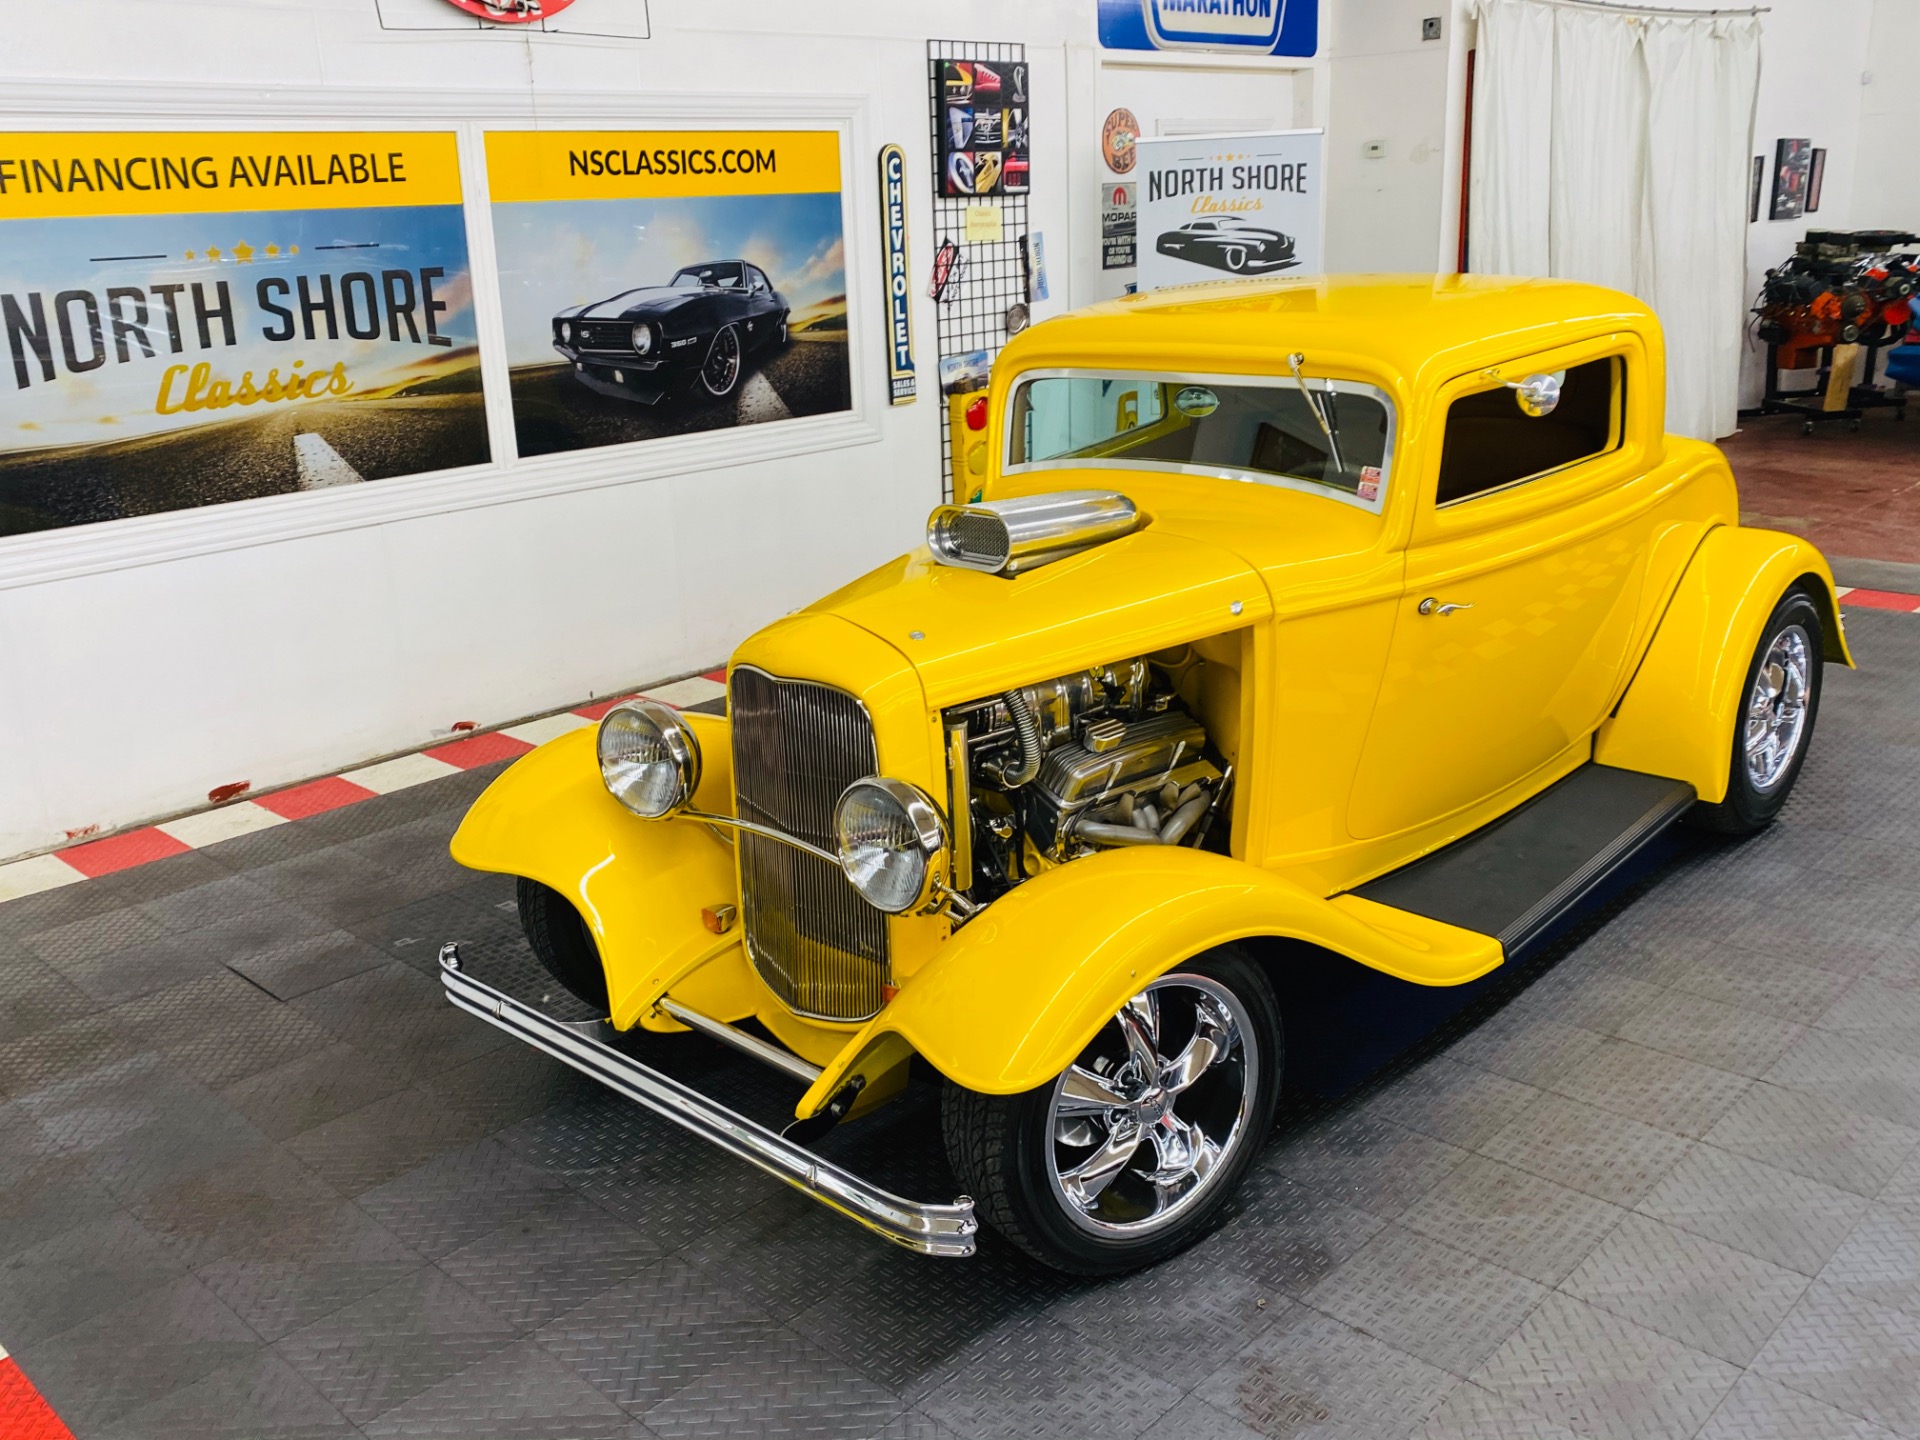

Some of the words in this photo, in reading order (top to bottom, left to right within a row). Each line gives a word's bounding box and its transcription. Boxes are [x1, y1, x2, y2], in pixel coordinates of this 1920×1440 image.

[0, 155, 218, 194] FINANCING
[229, 152, 407, 187] AVAILABLE
[568, 149, 777, 176] NSCLASSICS.COM
[1149, 167, 1223, 202] NORTH
[1232, 162, 1308, 194] SHORE
[1190, 195, 1263, 214] Classics
[888, 157, 907, 366] CHEVROLET
[0, 281, 238, 390] NORTH
[256, 267, 453, 348] SHORE
[155, 360, 356, 416] Classics
